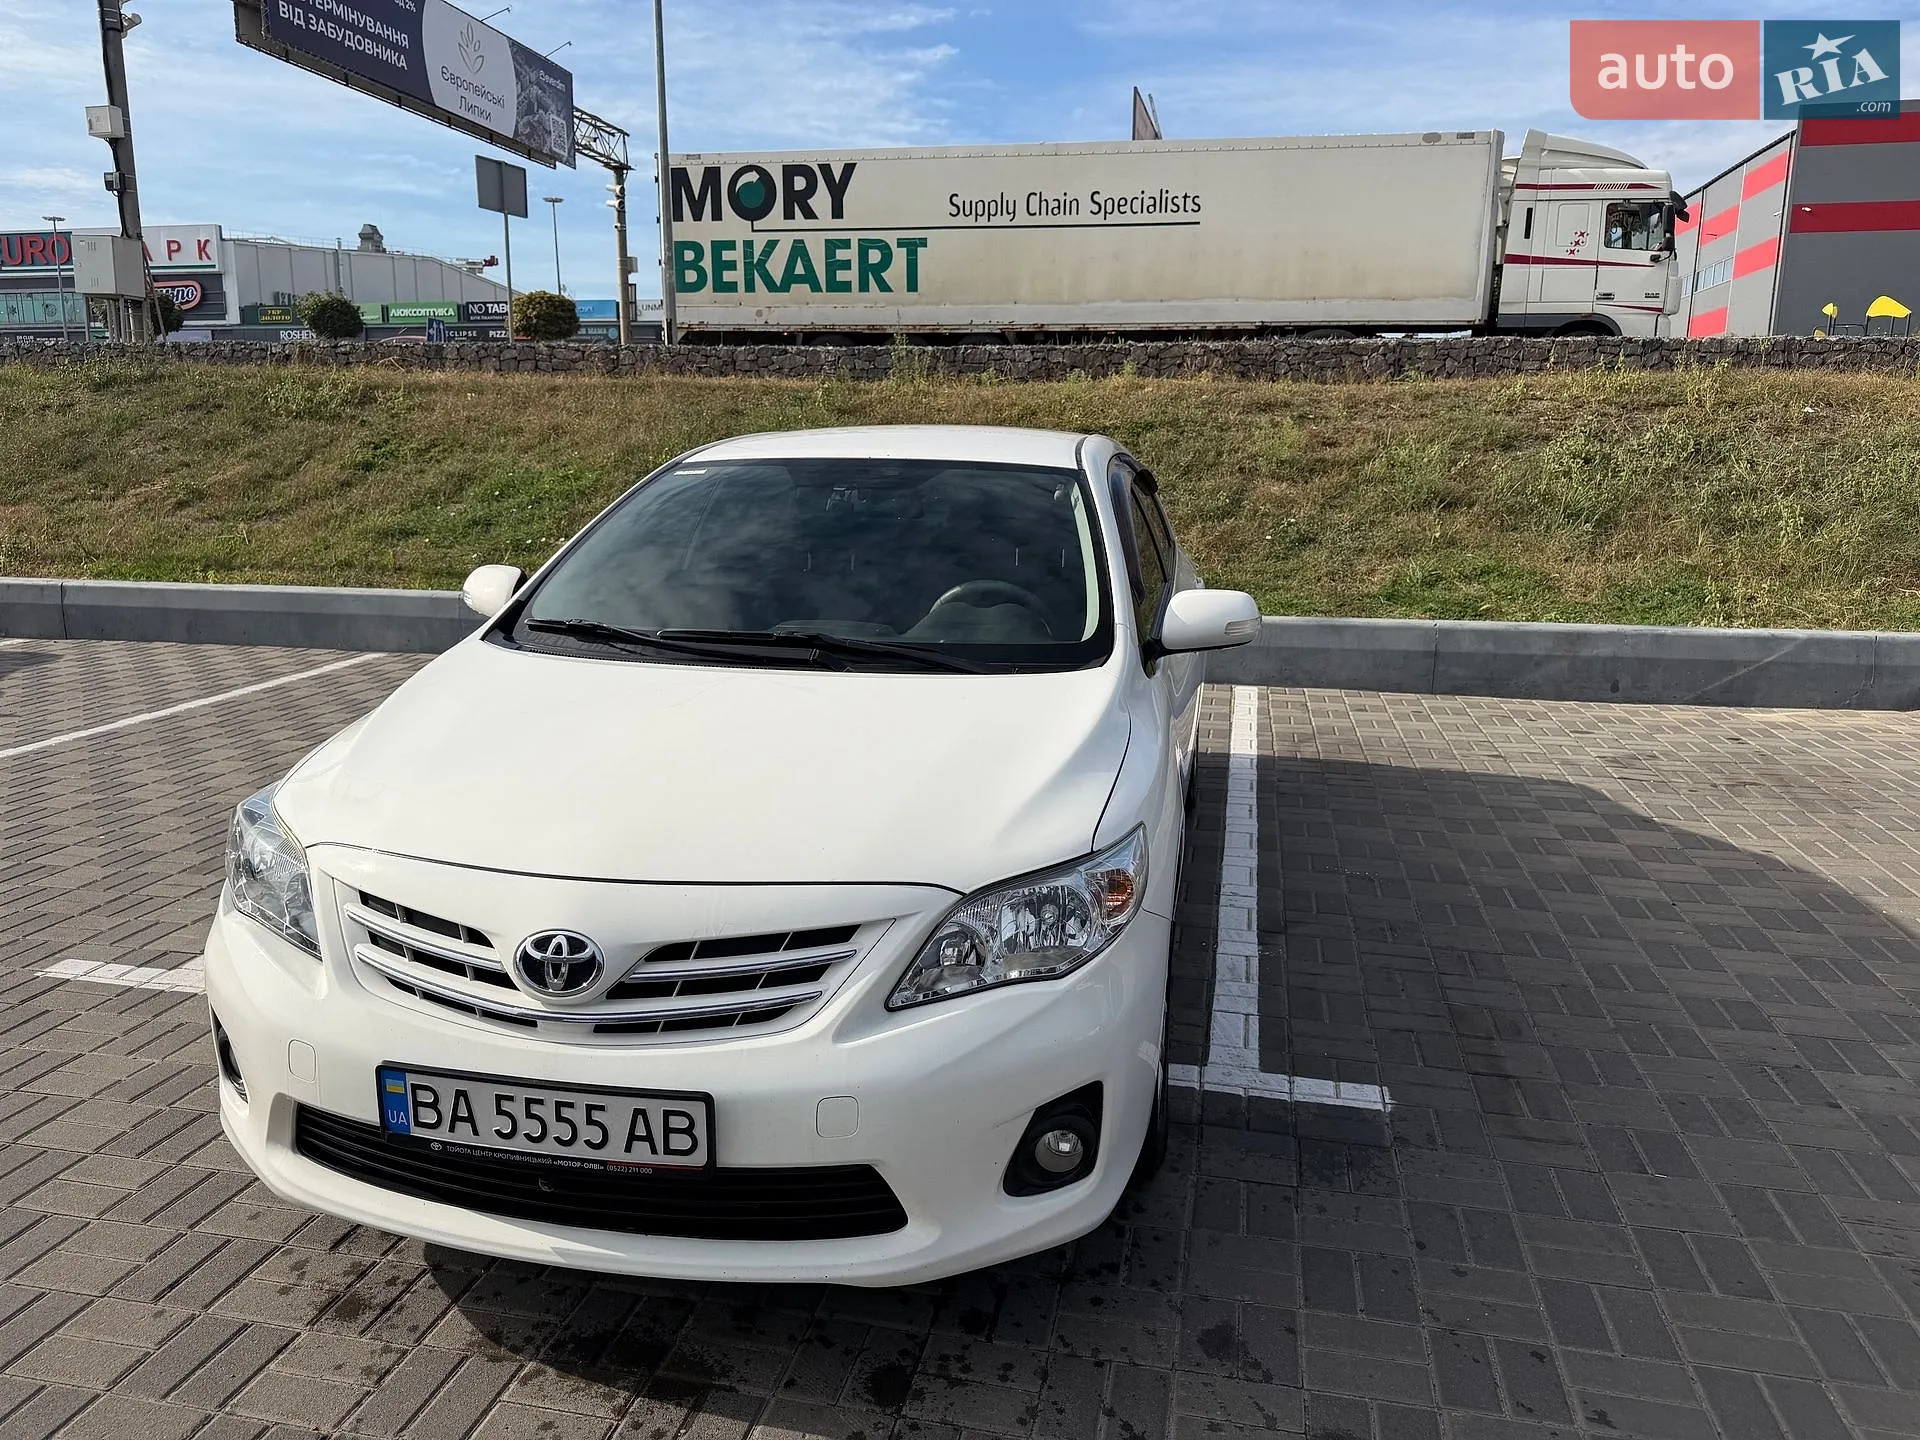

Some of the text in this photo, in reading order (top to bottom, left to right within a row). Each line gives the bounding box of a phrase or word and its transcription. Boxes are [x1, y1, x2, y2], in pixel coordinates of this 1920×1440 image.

[279, 0, 408, 71] ВІД ЗАБУДОВНИКА
[441, 65, 505, 109] Європейські
[460, 95, 493, 123] Липки
[670, 162, 1201, 222] MORY Supply Chain Specialists
[0, 234, 70, 266] URO
[674, 237, 928, 294] BEKAERT
[390, 307, 455, 318] ЛЮКСОПТИКА
[468, 303, 486, 314] NO
[387, 1109, 407, 1126] UA
[410, 1082, 699, 1157] BA 5555 AB
[446, 1145, 472, 1156] ТОЙОТА
[473, 1150, 493, 1159] ЦЕНТР
[606, 1165, 628, 1174] (0522)
[629, 1166, 639, 1174] 211
[640, 1167, 653, 1175] 000
